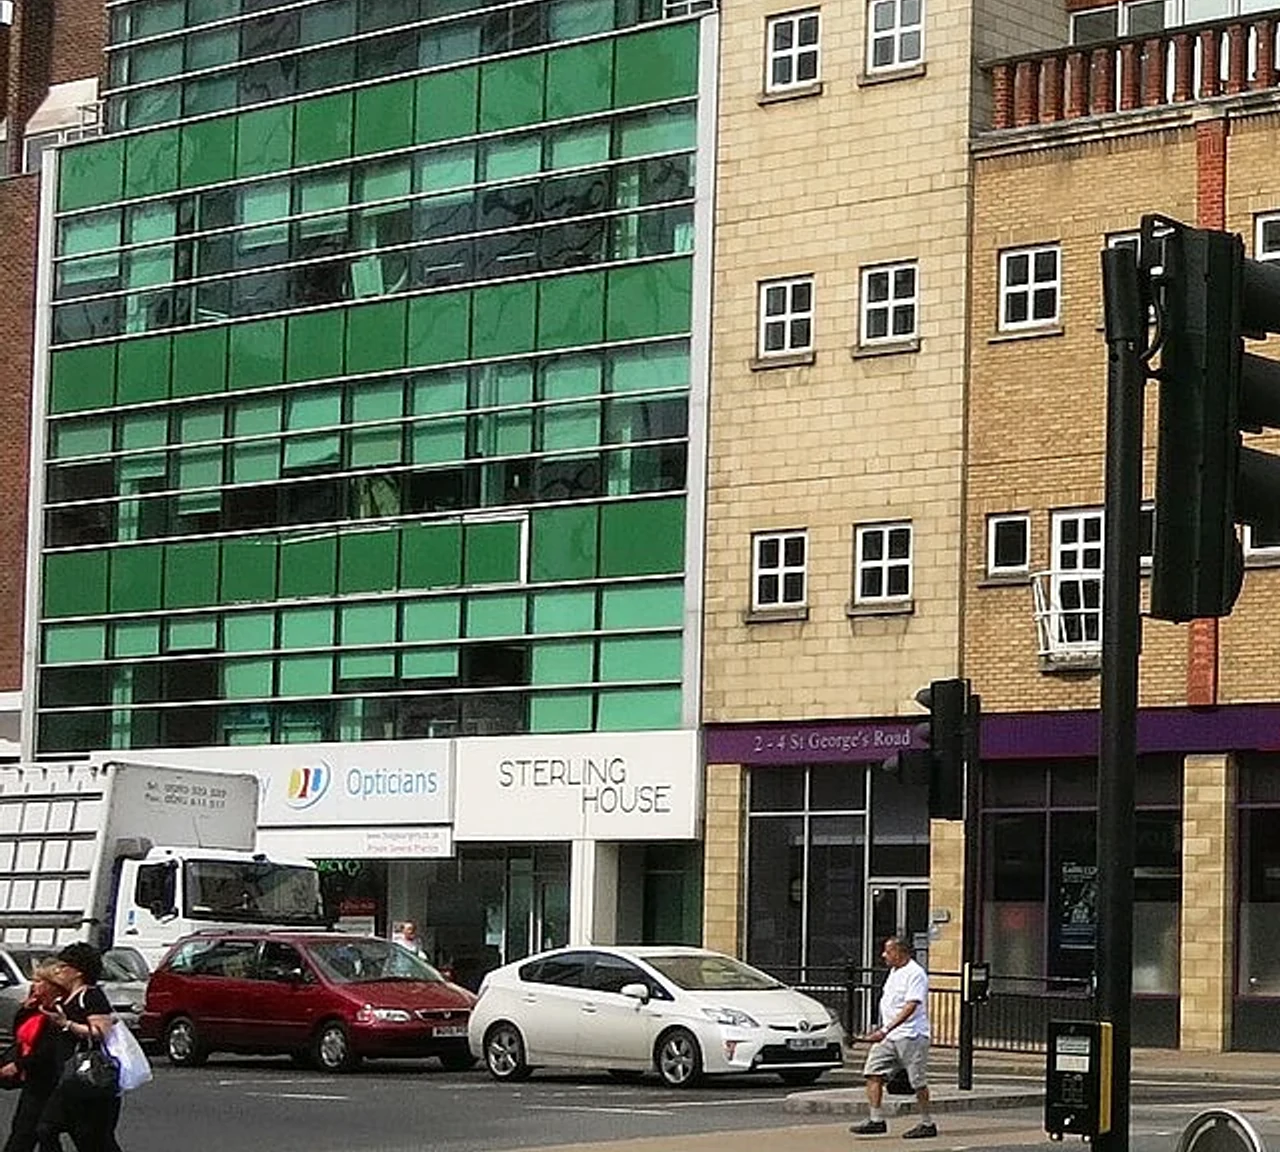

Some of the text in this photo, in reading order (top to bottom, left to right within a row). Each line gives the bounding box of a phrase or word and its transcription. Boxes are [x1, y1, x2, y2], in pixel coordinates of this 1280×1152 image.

[754, 736, 763, 751] 2
[790, 733, 804, 750] St
[808, 730, 870, 751] George's
[874, 728, 911, 746] Road
[346, 768, 438, 800] Opticians
[499, 757, 627, 787] STERLING
[582, 785, 672, 814] HOUSE
